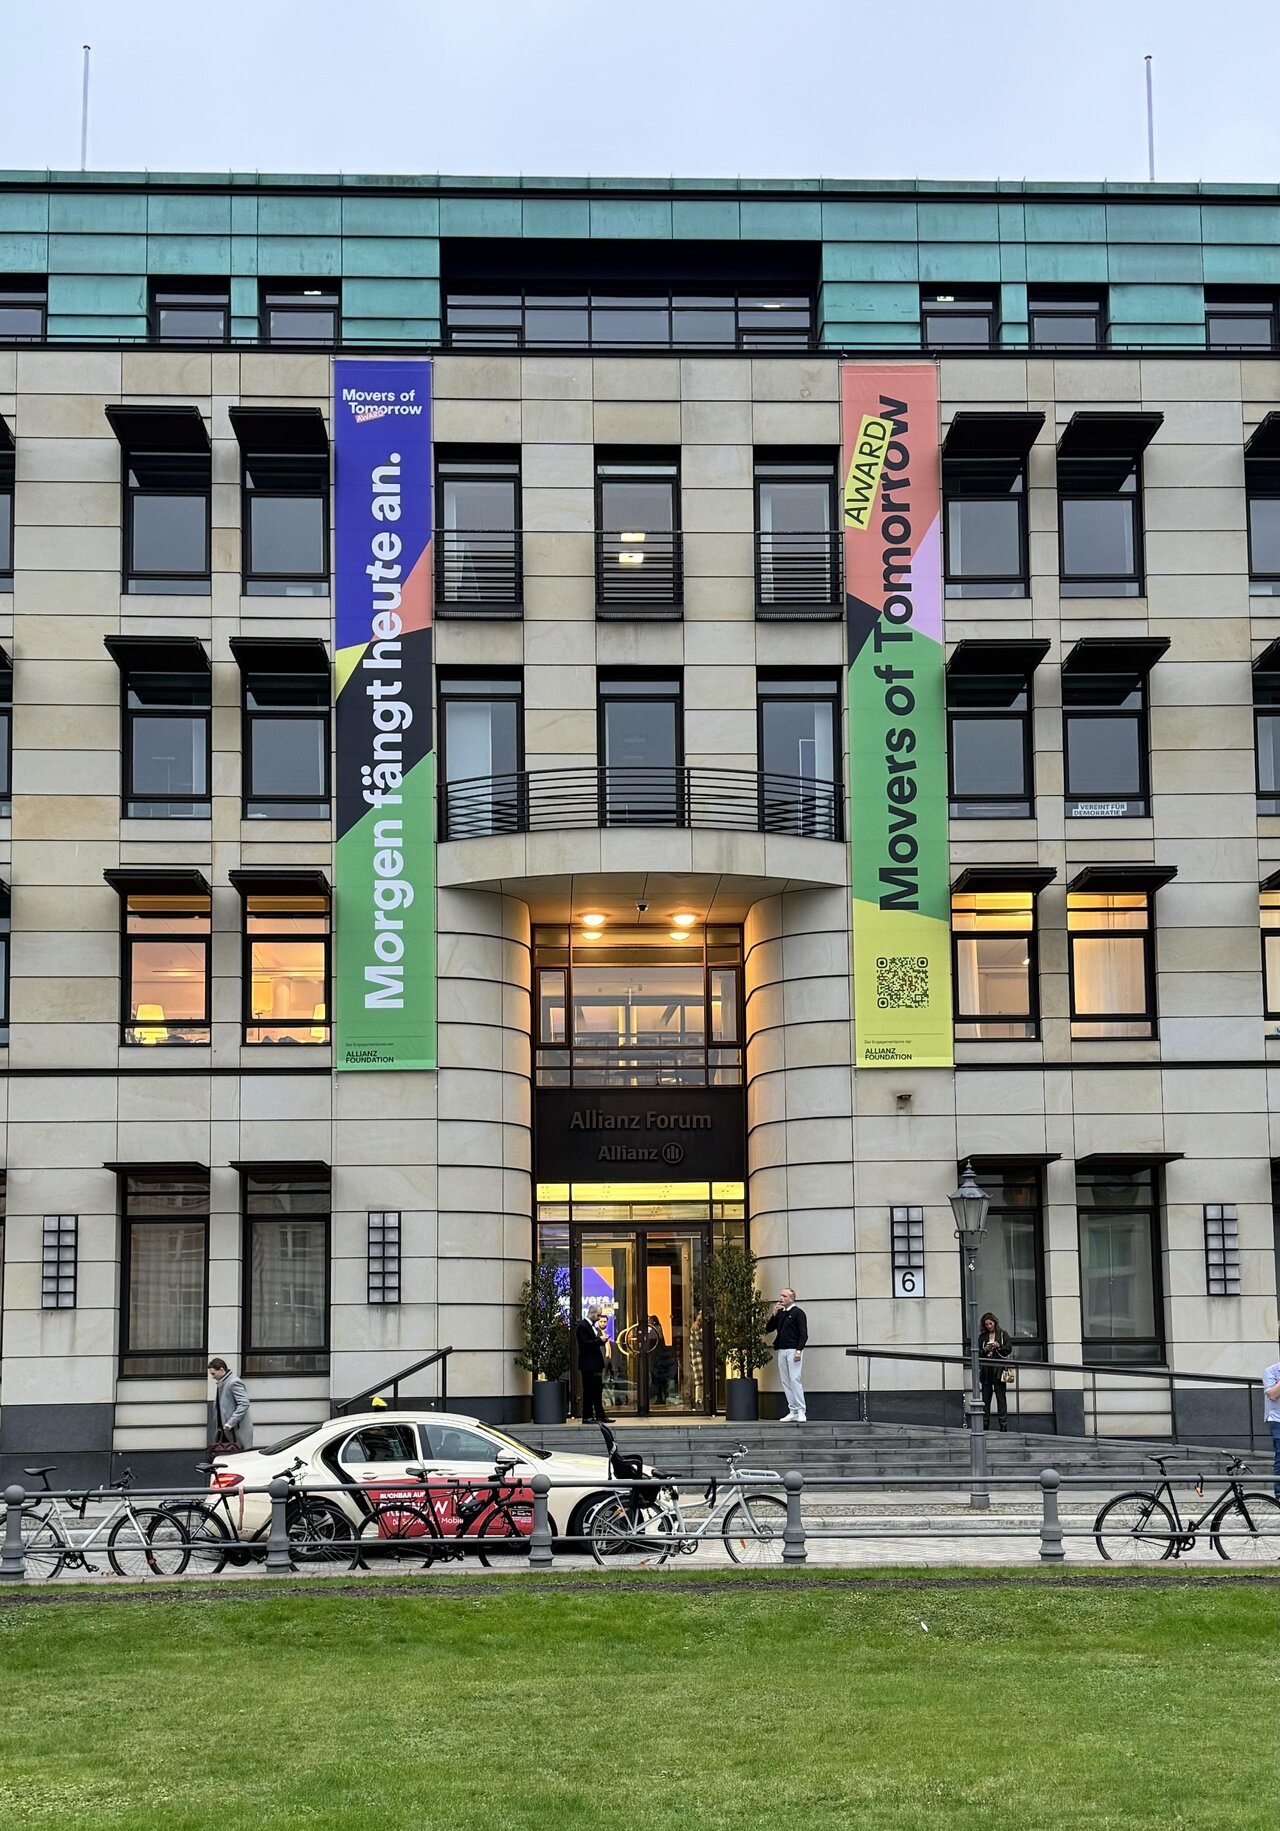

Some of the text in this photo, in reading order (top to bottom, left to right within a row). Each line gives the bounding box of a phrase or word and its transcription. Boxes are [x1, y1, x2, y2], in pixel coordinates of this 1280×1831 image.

[342, 388, 415, 401] Movers of
[348, 401, 422, 415] Tomorrow
[356, 410, 385, 422] AWARD
[845, 420, 887, 525] AWARD
[873, 394, 919, 911] Movers of Tomorrow
[360, 452, 415, 1009] Morgen fängt heute an.
[1111, 802, 1125, 810] FÜR
[569, 1109, 713, 1130] Allianz Forum
[598, 1144, 658, 1161] Allianz
[902, 1271, 916, 1293] 6
